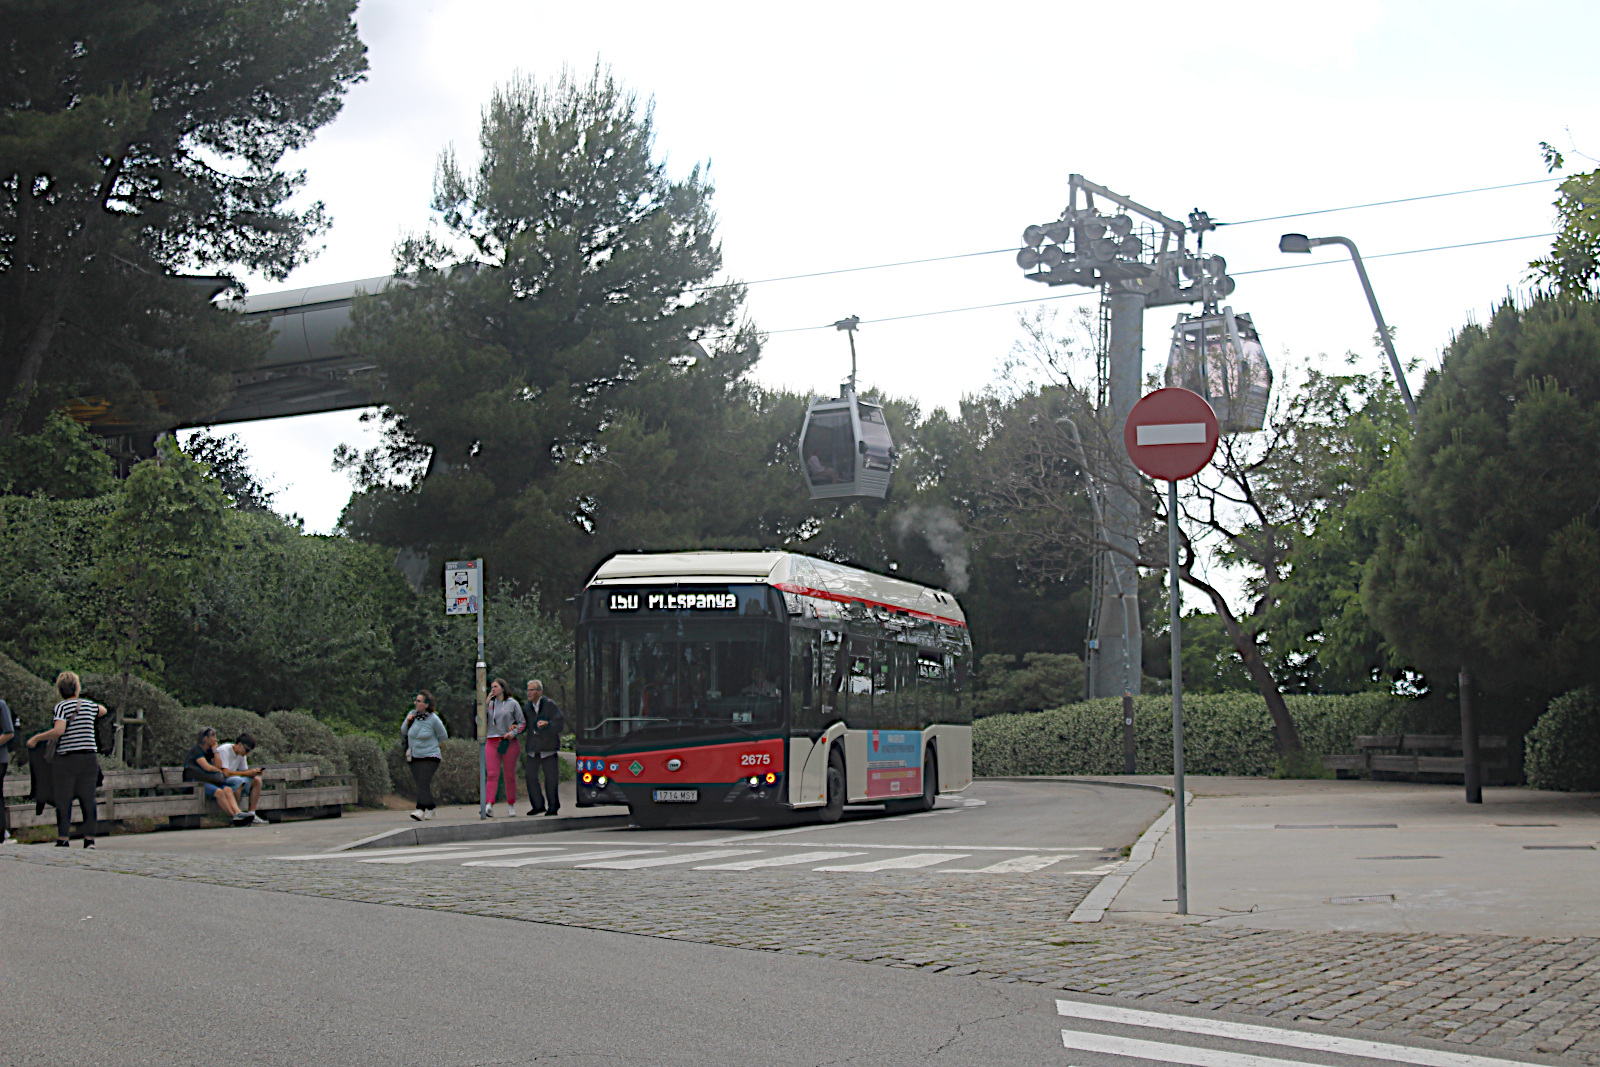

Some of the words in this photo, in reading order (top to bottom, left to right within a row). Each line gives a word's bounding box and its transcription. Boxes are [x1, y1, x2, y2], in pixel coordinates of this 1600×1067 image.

[741, 754, 771, 766] 2675
[659, 790, 678, 800] 1714
[680, 790, 696, 800] MSY
